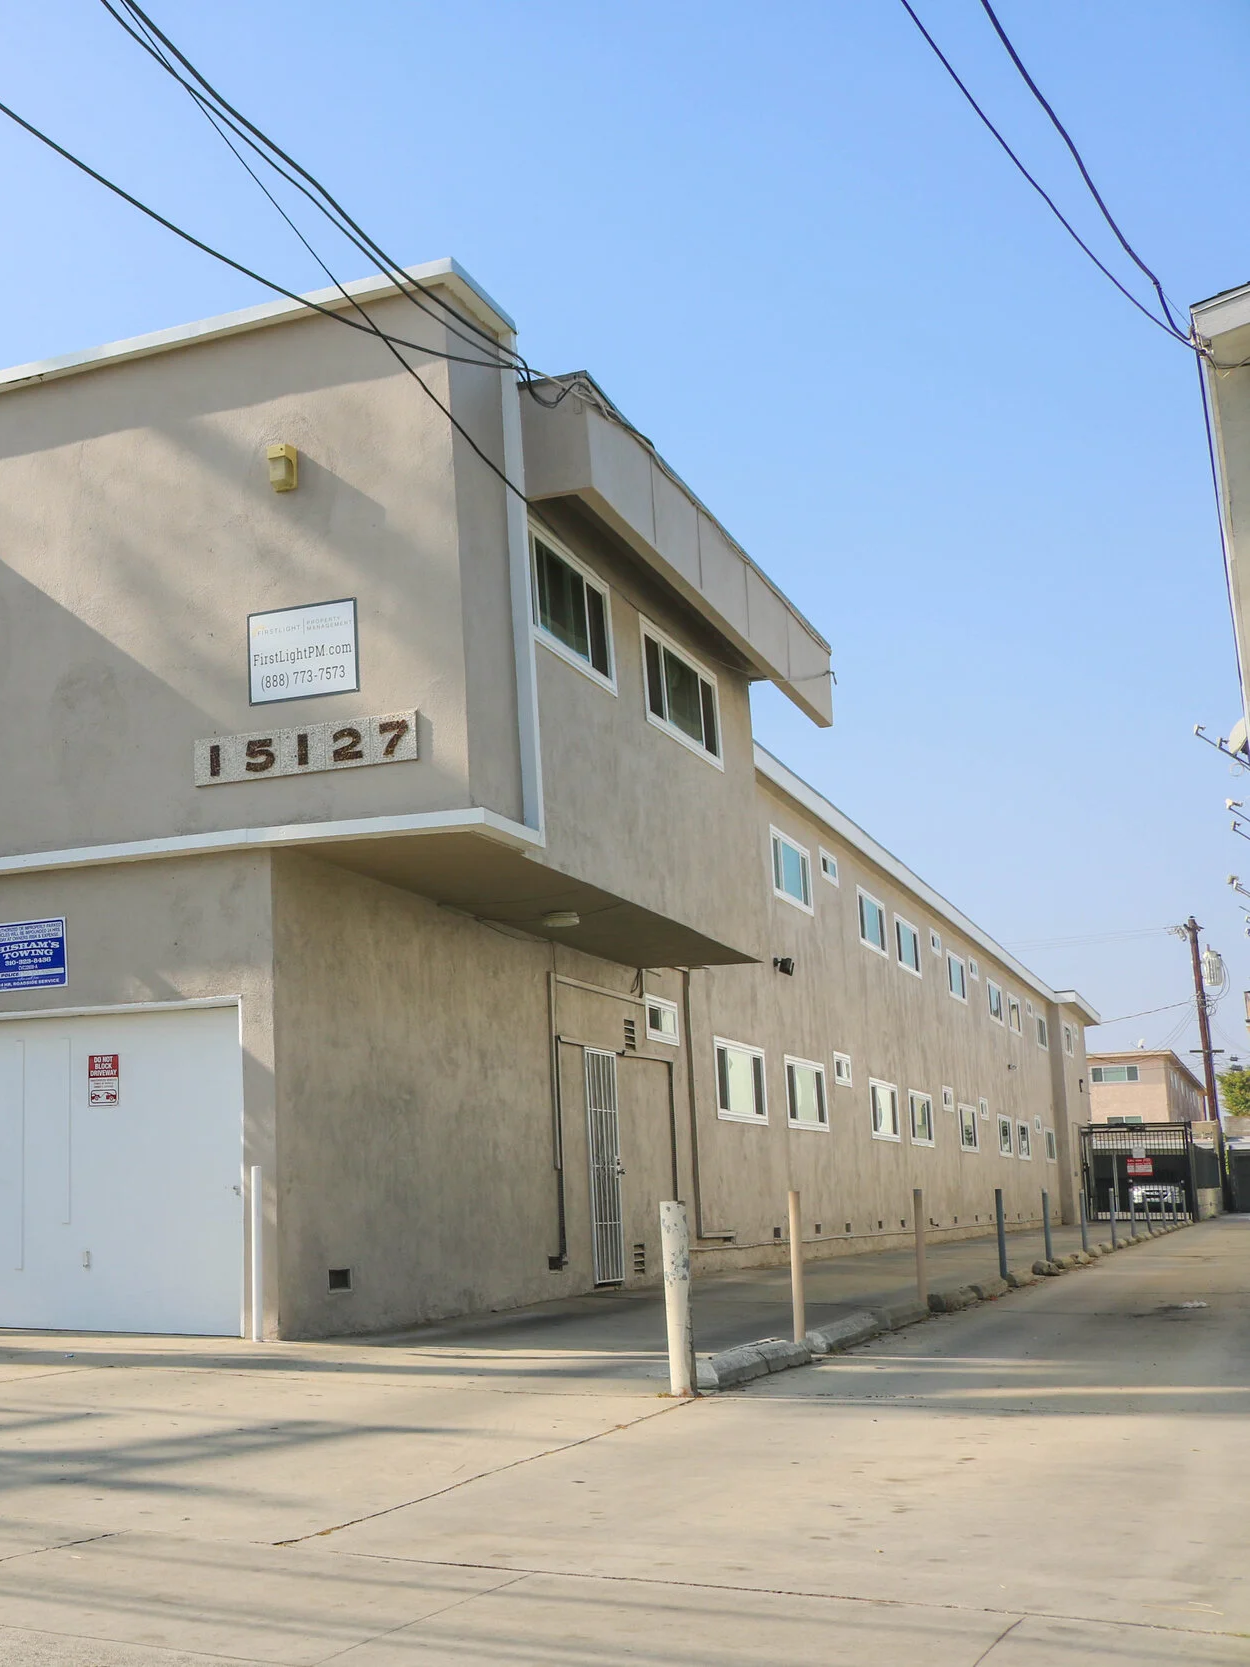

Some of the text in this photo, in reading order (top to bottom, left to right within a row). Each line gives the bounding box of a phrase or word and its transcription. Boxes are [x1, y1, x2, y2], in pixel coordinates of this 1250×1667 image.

[254, 642, 352, 666] FirstLightPM.com
[261, 665, 346, 692] (888) 773-7573
[210, 719, 408, 777] 15127
[3, 949, 53, 960] TOWING
